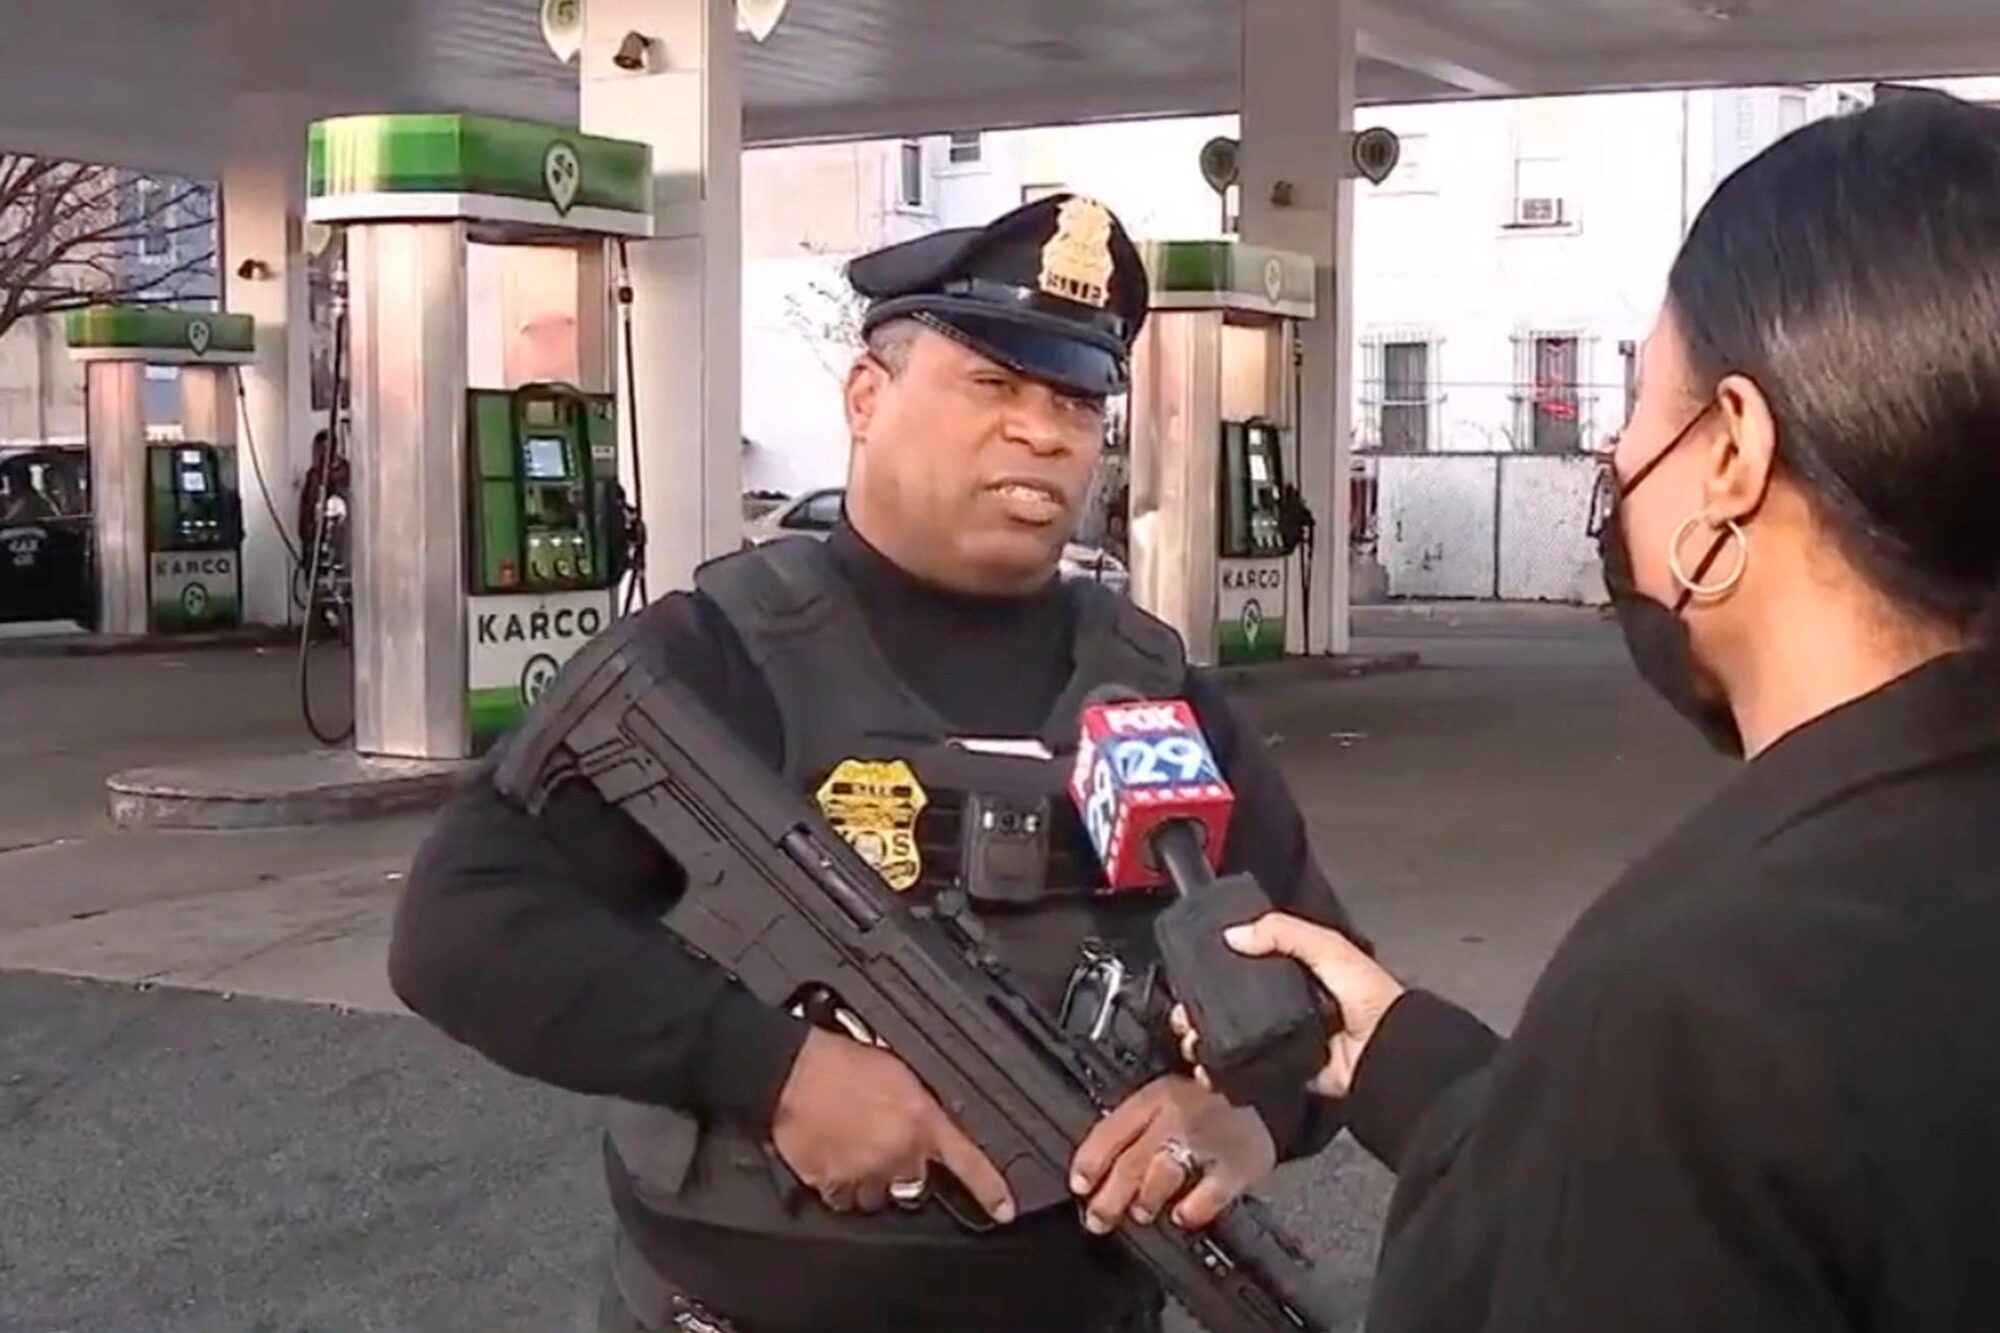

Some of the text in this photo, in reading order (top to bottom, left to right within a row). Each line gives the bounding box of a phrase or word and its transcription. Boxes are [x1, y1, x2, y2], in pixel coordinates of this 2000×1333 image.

[477, 607, 600, 643] KARCO
[1104, 702, 1184, 732] FOX
[1114, 738, 1203, 784] 29
